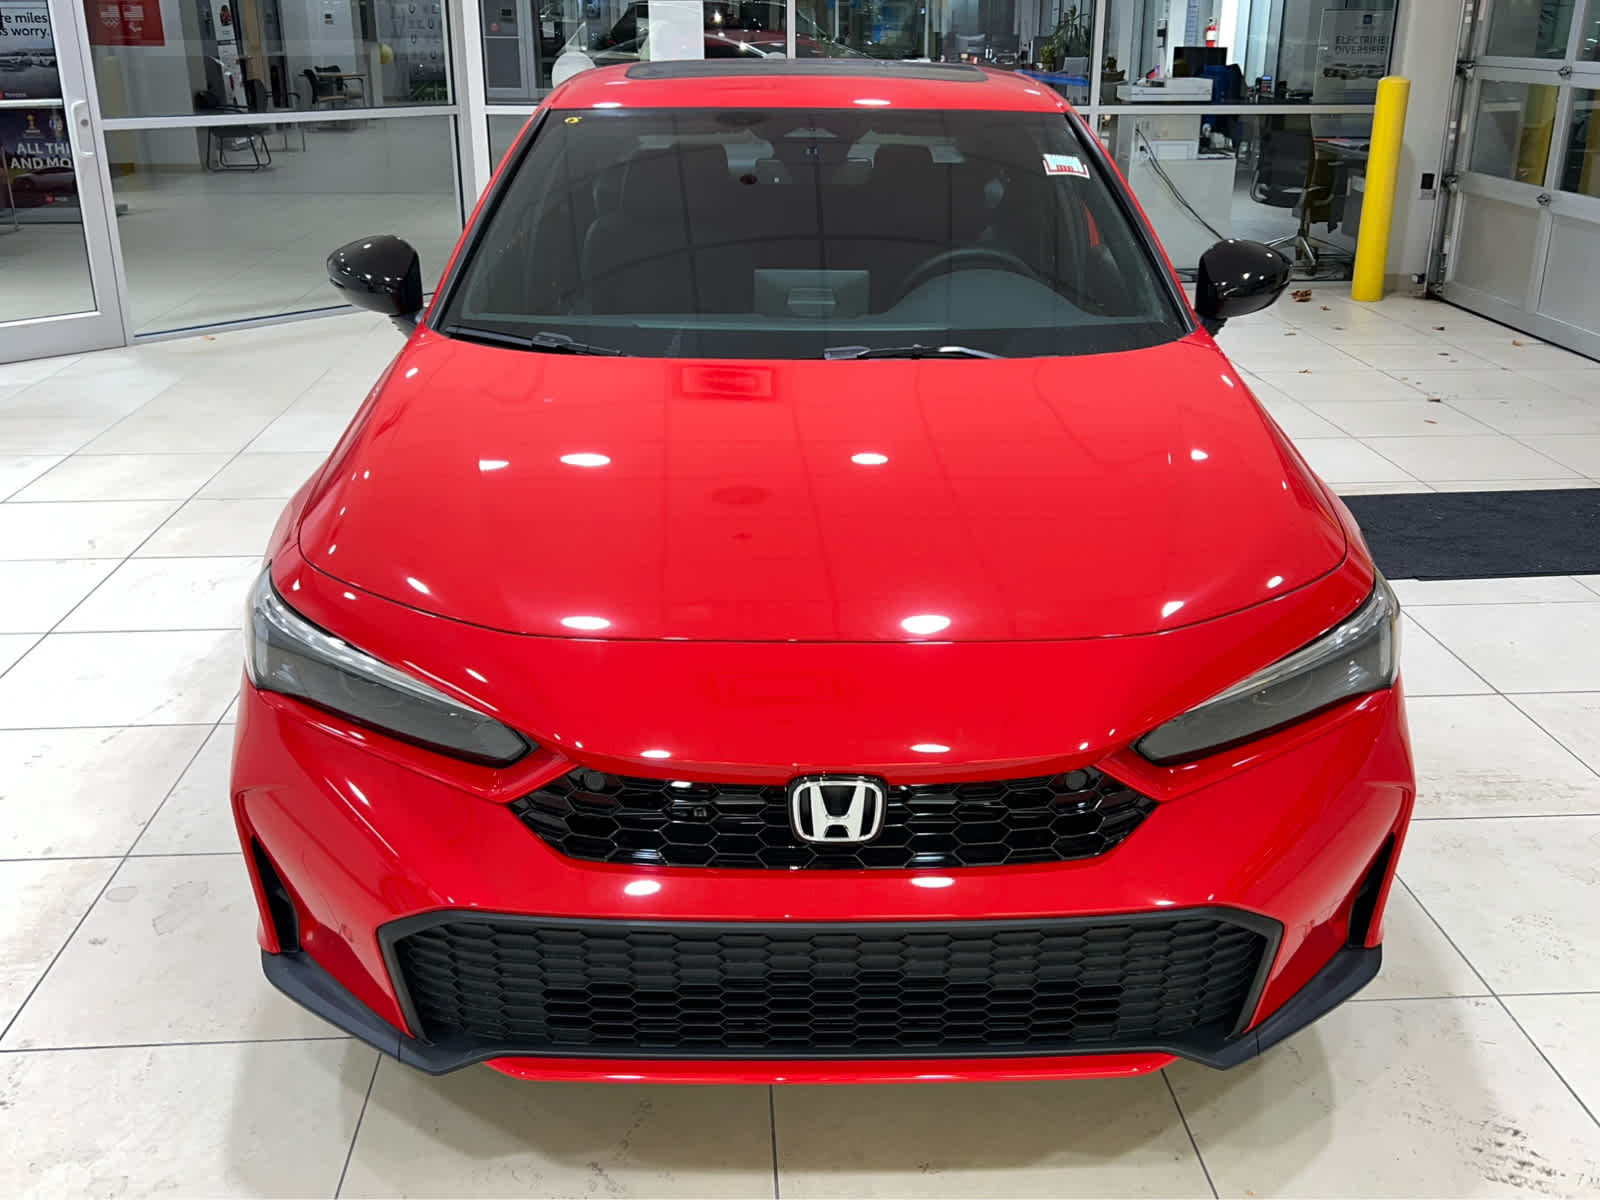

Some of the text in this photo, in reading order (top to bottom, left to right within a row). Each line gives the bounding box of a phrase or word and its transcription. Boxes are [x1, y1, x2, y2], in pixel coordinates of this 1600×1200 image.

[14, 12, 48, 24] miles
[10, 27, 50, 40] worry.
[17, 143, 71, 155] ALL THI
[11, 157, 73, 169] AND MO
